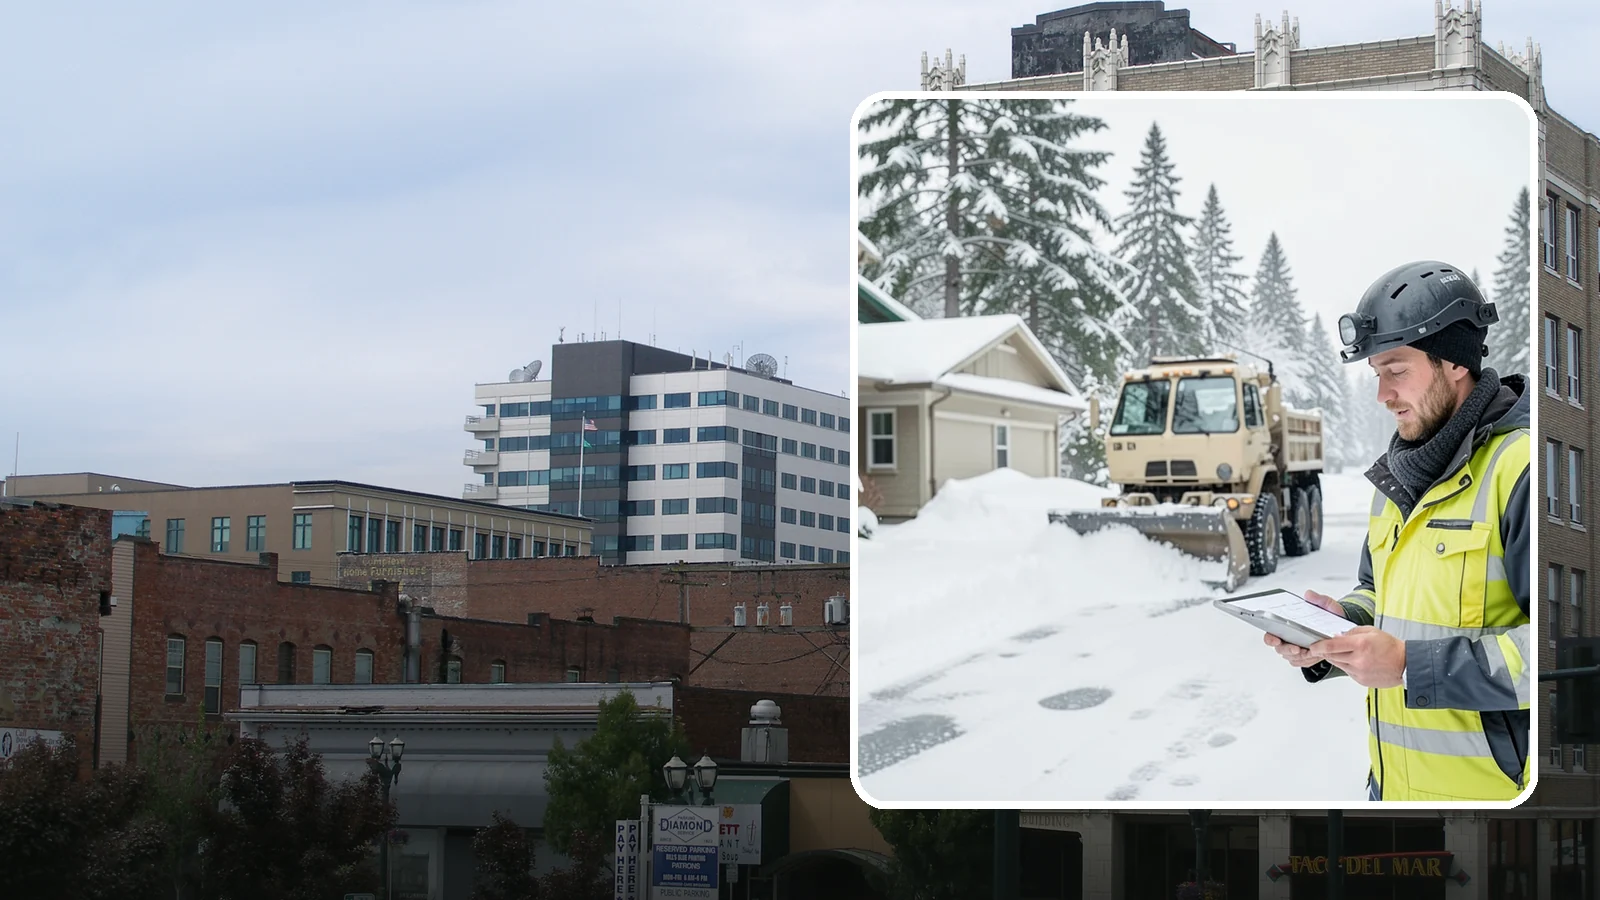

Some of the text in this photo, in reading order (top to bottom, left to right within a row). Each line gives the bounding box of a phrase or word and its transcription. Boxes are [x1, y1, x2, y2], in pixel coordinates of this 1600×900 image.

[343, 566, 427, 577] Home Furnishers
[1022, 815, 1070, 828] BUILDING
[656, 845, 688, 853] RESERVED
[616, 825, 625, 893] PAY HERE
[628, 824, 636, 893] PAY HERE
[721, 851, 739, 862] Soup
[671, 862, 701, 870] PATRONS
[1346, 856, 1385, 876] DEL
[1392, 857, 1443, 877] MAR
[660, 889, 710, 898] PUBLIC PARKING
